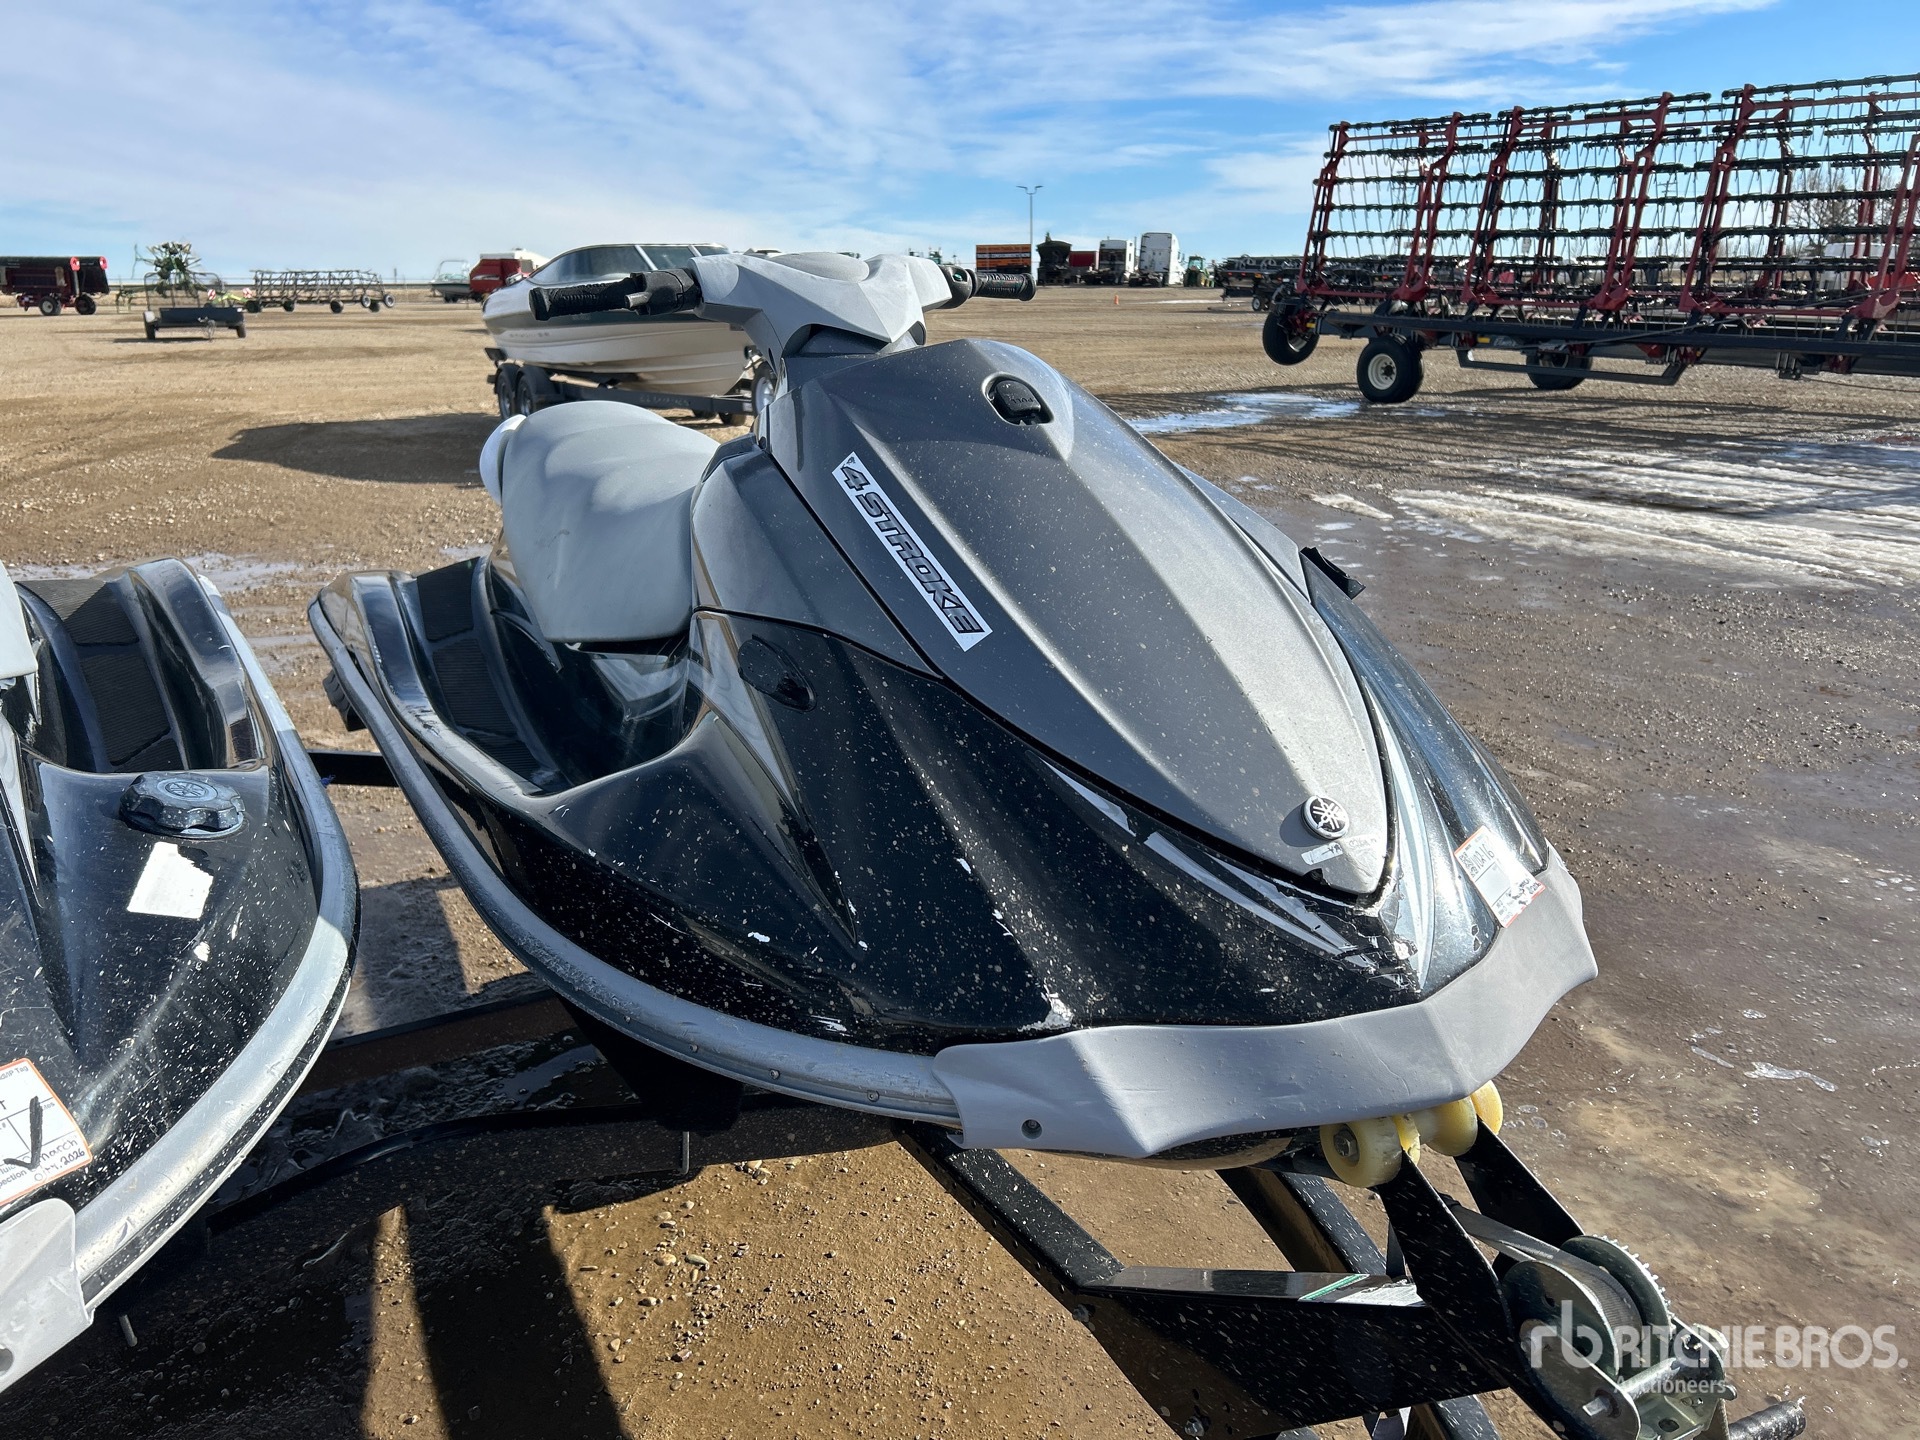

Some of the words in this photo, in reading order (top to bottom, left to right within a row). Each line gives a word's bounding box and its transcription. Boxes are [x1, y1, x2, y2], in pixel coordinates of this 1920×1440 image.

[841, 466, 870, 491] 4
[856, 492, 985, 634] STROKE
[14, 1065, 29, 1074] Tag
[60, 1148, 85, 1166] 2026
